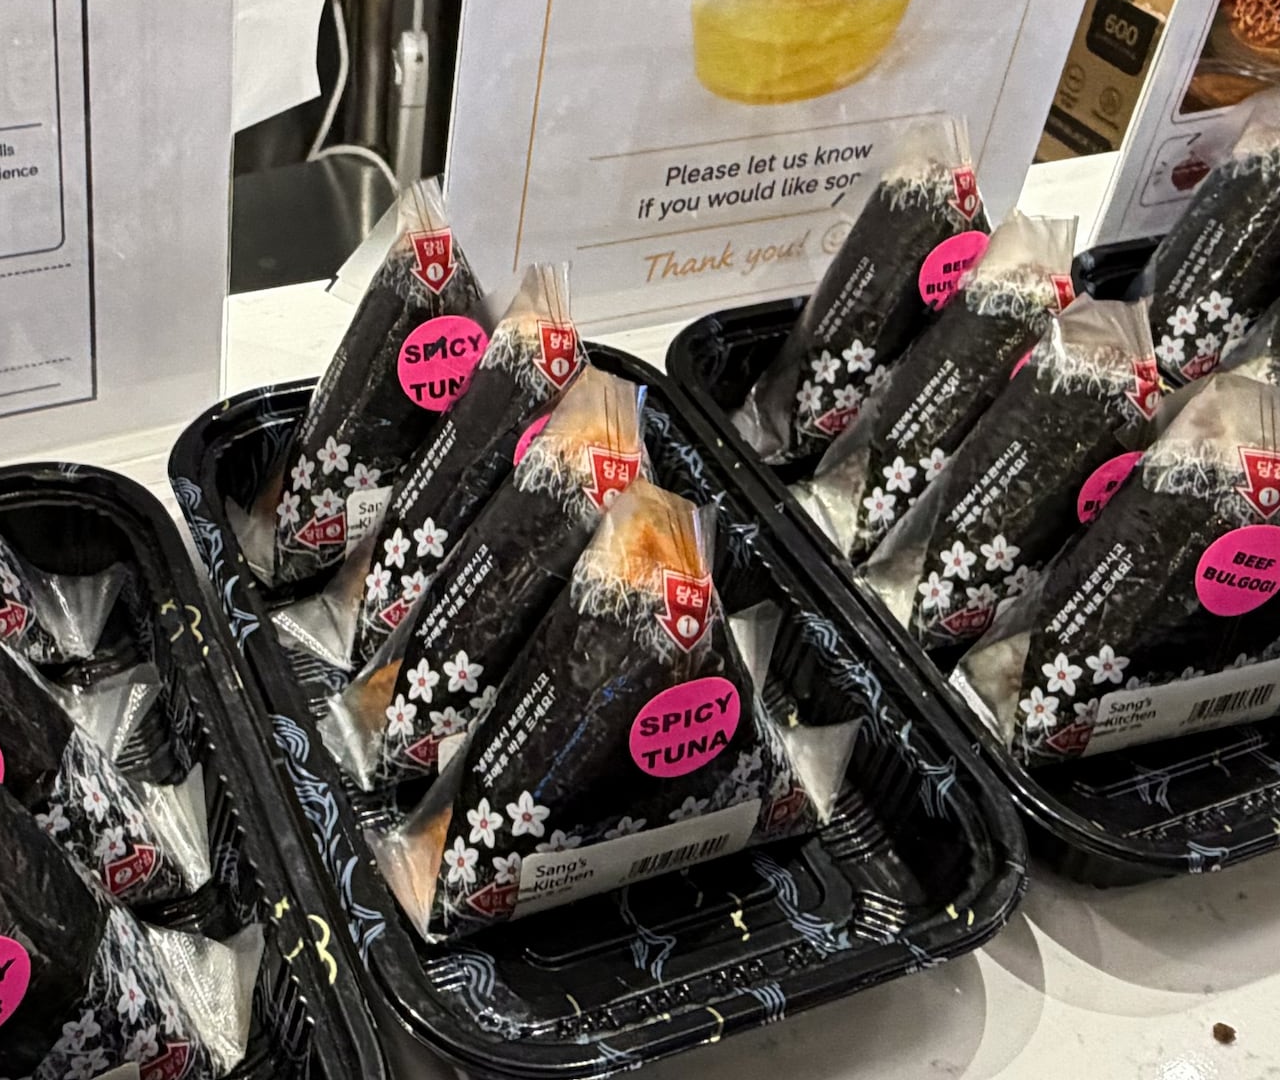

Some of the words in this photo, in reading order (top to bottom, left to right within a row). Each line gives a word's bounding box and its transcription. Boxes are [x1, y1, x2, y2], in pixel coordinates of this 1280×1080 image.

[1104, 13, 1139, 47] 600
[665, 162, 740, 188] Please
[746, 156, 777, 177] let
[782, 151, 809, 171] us
[813, 142, 874, 167] know
[637, 197, 656, 220] if
[657, 195, 700, 222] you
[708, 185, 776, 209] would
[780, 175, 819, 199] like
[643, 240, 732, 284] Thank
[744, 229, 812, 277] you!
[403, 333, 482, 365] SPICY
[409, 375, 467, 403] TUN
[1232, 551, 1277, 571] BEEF
[1202, 565, 1277, 594] BULGOGI
[639, 690, 733, 738] SPICY
[1104, 709, 1157, 728] Kitchen
[641, 728, 729, 770] TUNA
[534, 869, 594, 893] Kitchen
